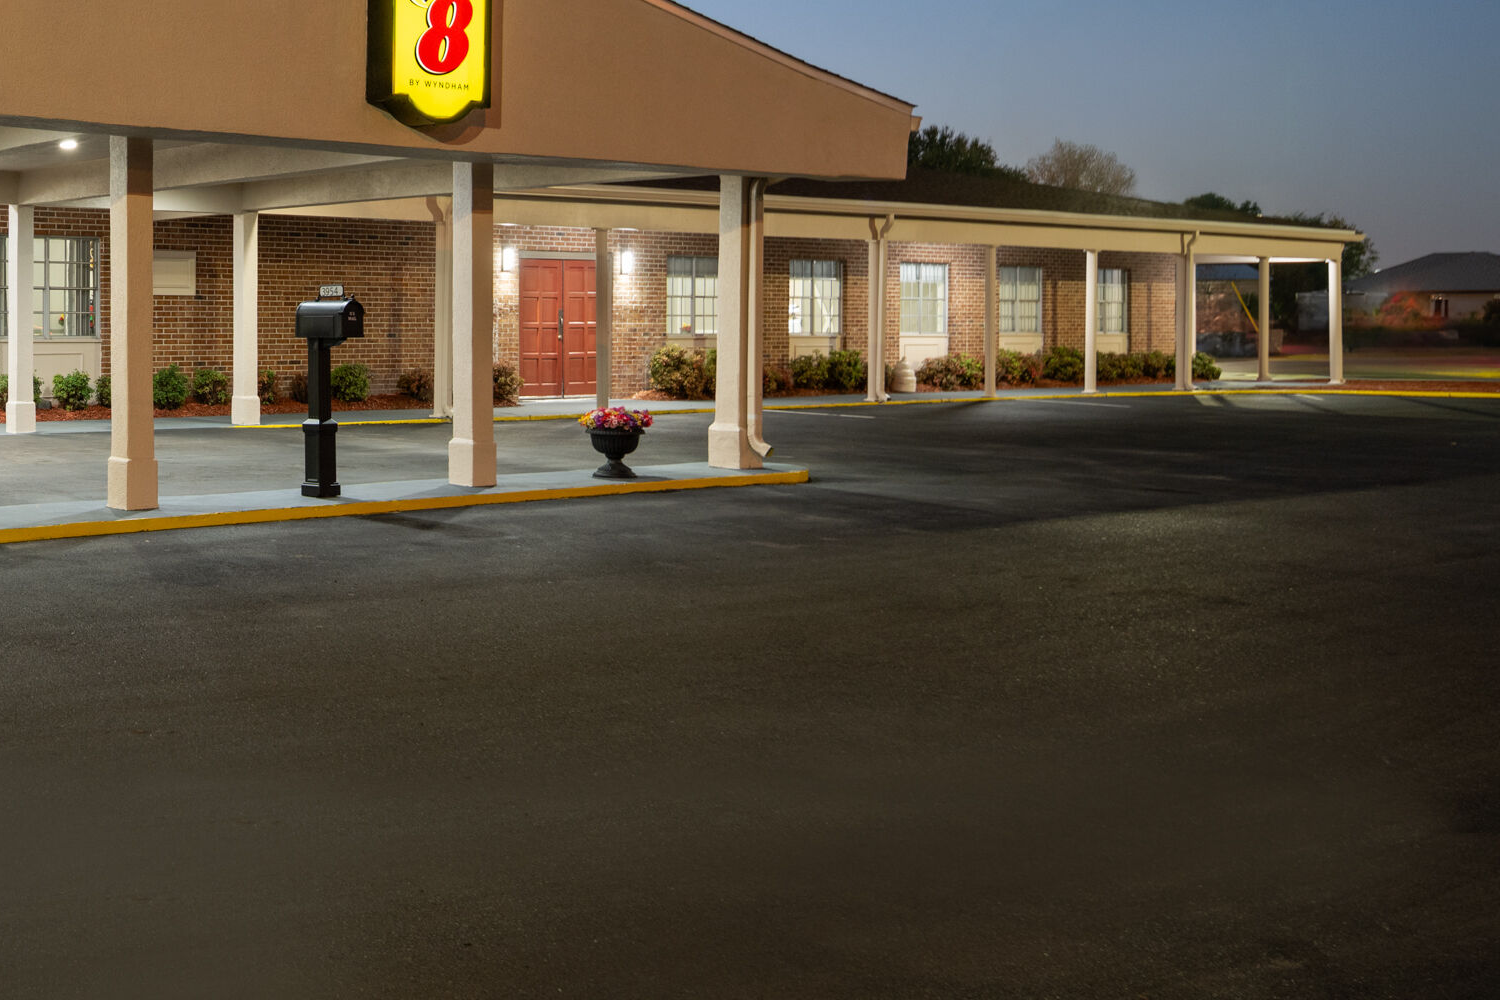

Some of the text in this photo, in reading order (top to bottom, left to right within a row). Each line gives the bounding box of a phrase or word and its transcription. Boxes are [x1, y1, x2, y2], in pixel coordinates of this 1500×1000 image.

[409, 79, 469, 91] BY WYNDHAM
[321, 287, 338, 296] 3954
